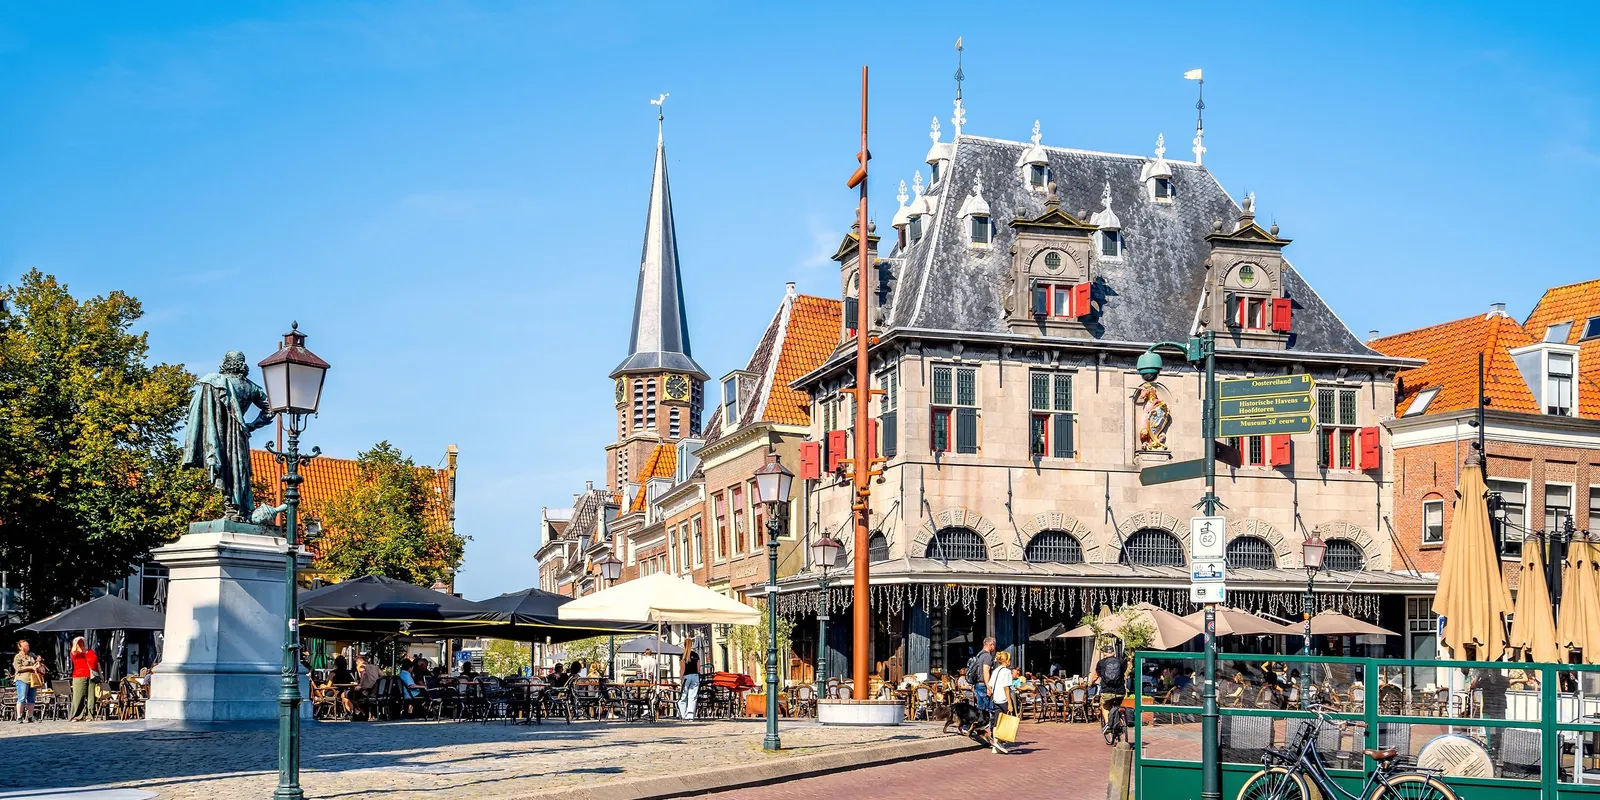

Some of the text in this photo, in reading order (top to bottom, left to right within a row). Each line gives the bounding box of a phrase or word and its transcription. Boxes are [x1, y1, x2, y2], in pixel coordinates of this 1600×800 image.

[1252, 378, 1292, 387] Oostereiland
[1240, 419, 1267, 427] Museum
[1202, 535, 1213, 543] 62
